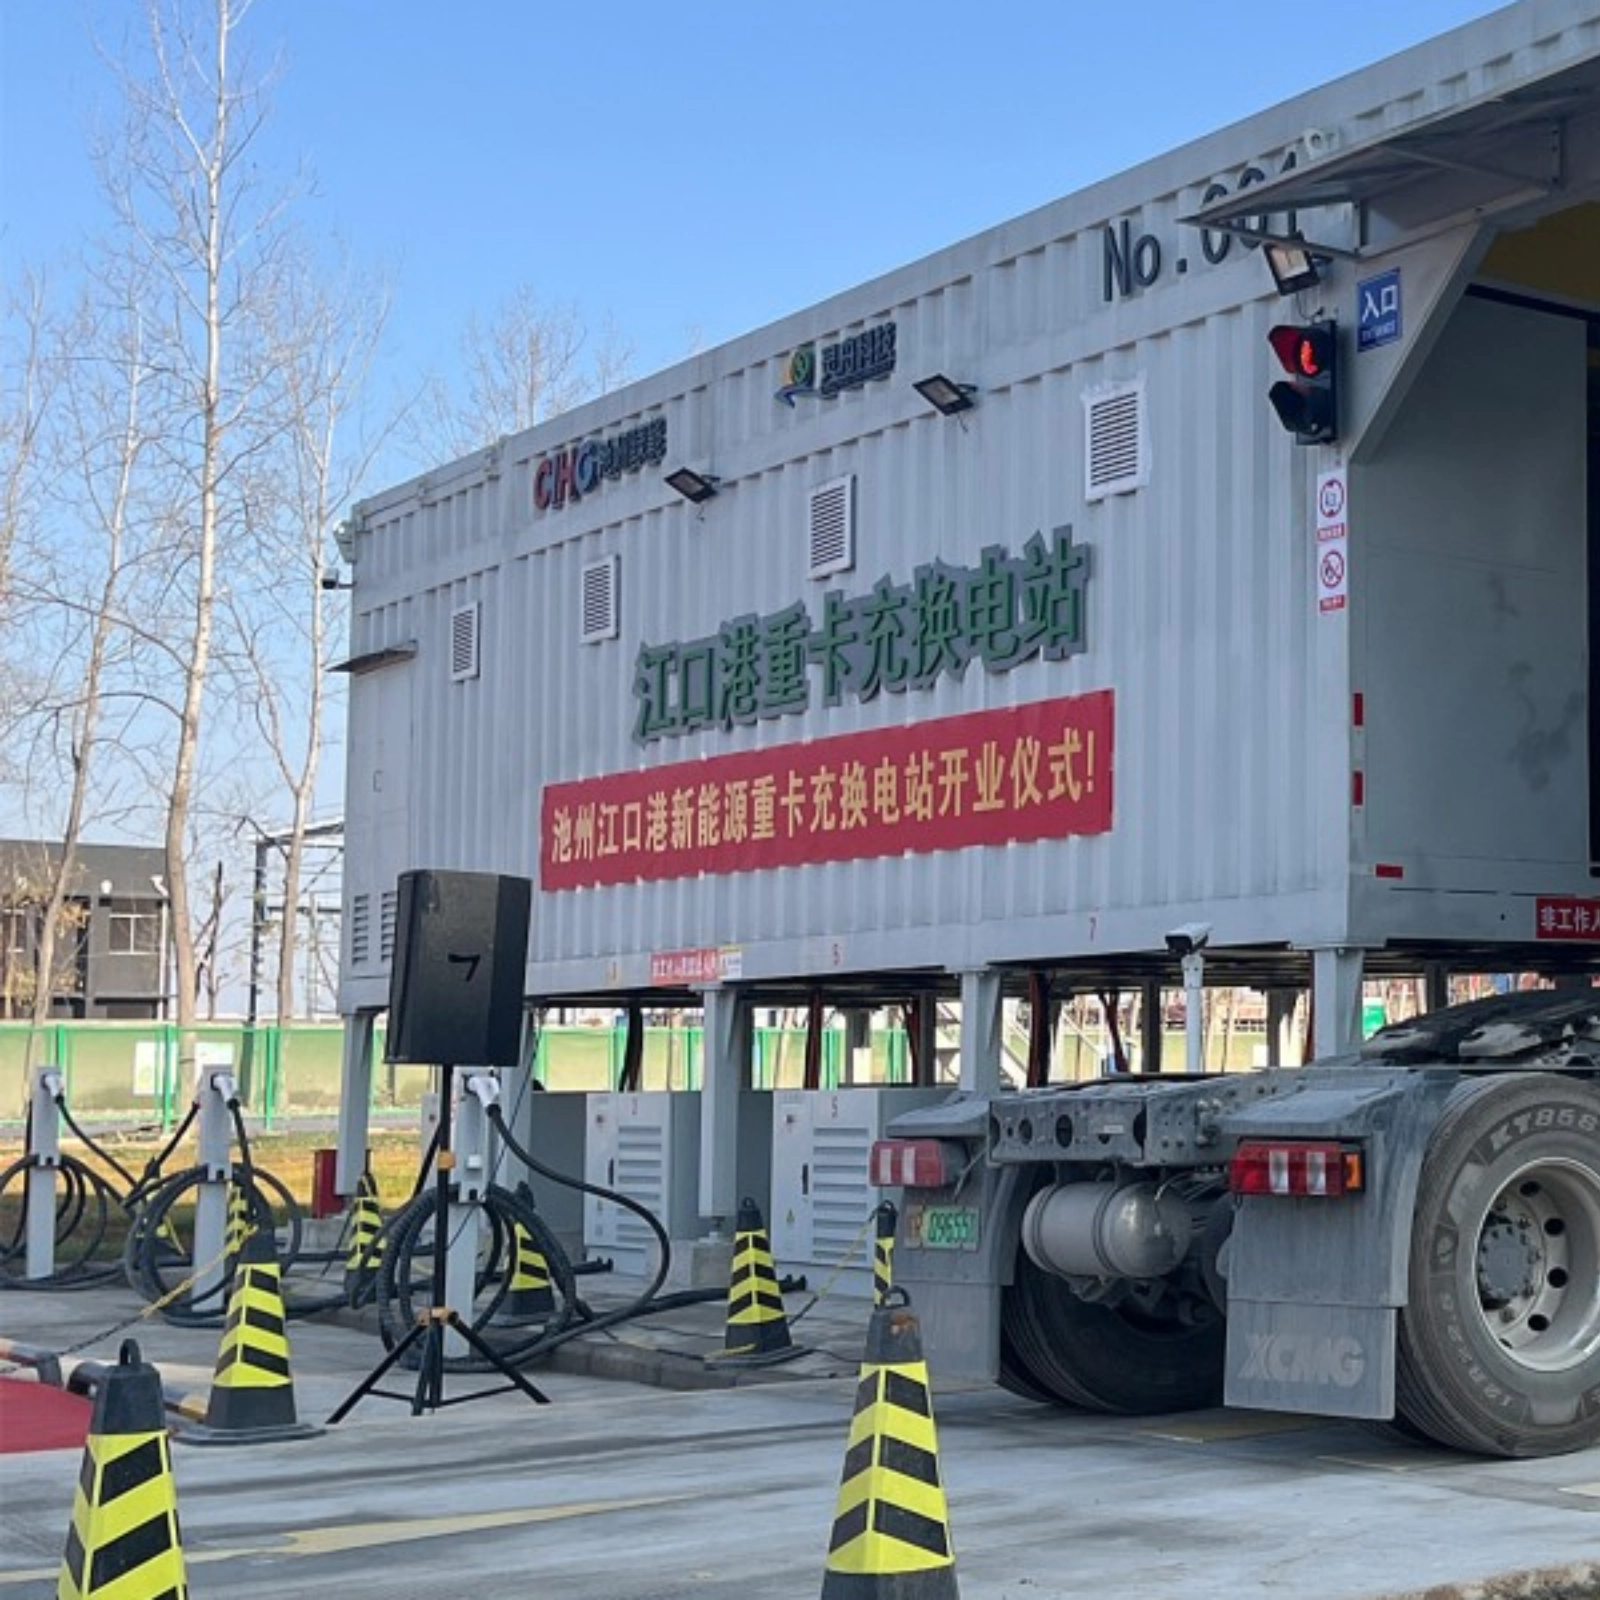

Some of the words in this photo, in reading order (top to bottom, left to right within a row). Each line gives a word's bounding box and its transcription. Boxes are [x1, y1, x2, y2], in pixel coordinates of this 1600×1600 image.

[1362, 285, 1398, 323] 入口
[636, 530, 1090, 741] 江口港重卡充换电站
[552, 727, 1094, 863] 池州江口港新能源重卡充换电站开业仪式!
[1489, 1107, 1599, 1151] KT858
[1236, 1333, 1367, 1389] XCMG
